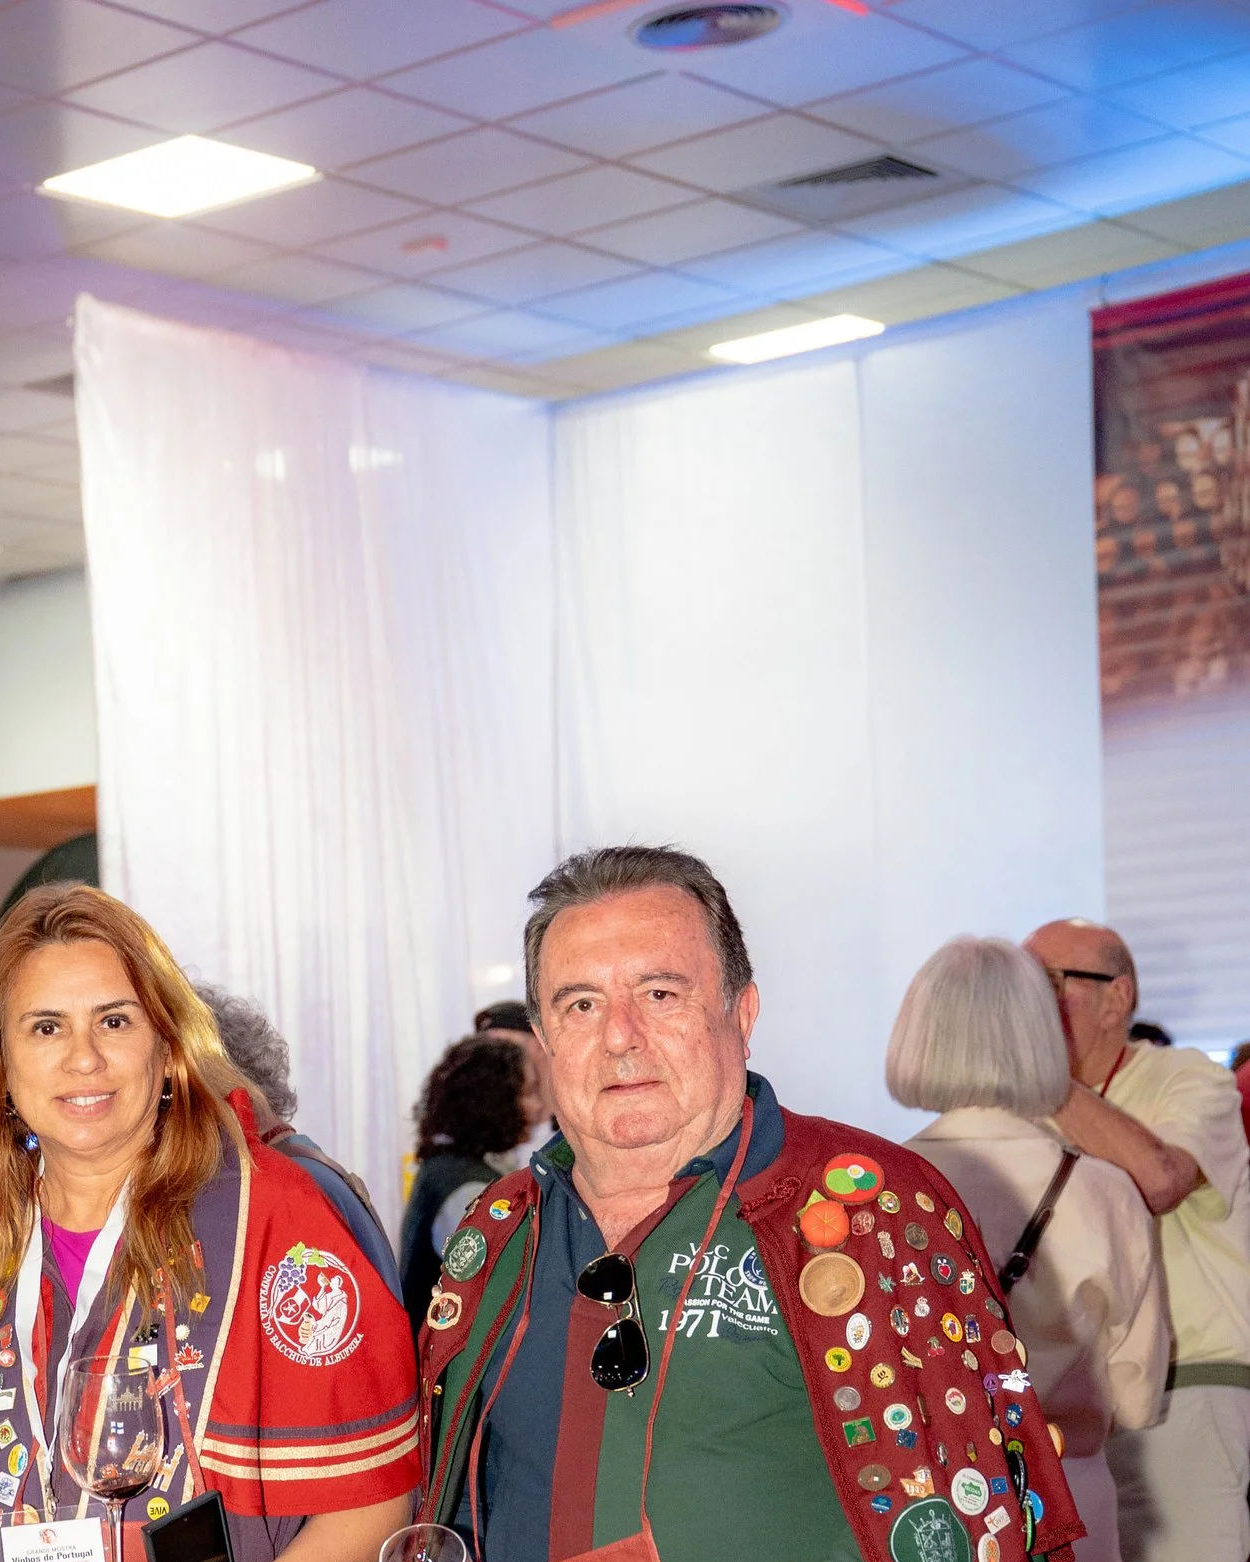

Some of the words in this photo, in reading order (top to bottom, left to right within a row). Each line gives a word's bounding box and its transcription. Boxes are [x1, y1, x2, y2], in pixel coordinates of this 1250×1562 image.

[668, 1253, 744, 1287] POLO
[259, 1265, 276, 1322] CONFRARIA
[700, 1274, 778, 1315] TEAM
[658, 1308, 721, 1338] 1971
[684, 1298, 711, 1307] ASSION
[711, 1299, 728, 1310] FOR
[729, 1307, 744, 1319] THE
[745, 1314, 770, 1324] GAME
[262, 1322, 275, 1335] DO
[270, 1335, 307, 1367] BACCHUS
[309, 1358, 322, 1367] DE
[324, 1332, 364, 1367] ALBUFEIRA
[43, 1553, 54, 1561] de
[57, 1549, 93, 1560] Portugal
